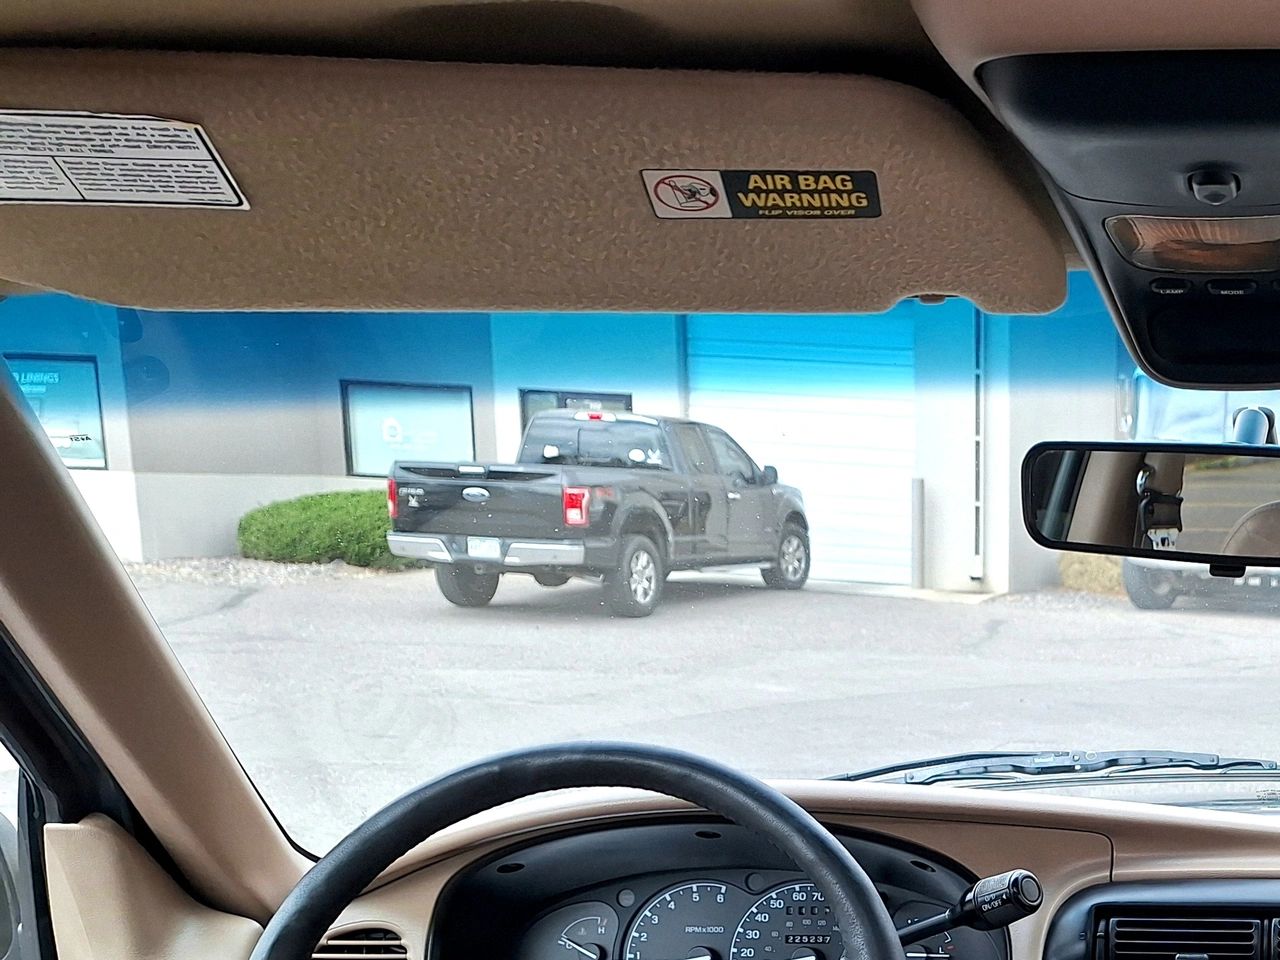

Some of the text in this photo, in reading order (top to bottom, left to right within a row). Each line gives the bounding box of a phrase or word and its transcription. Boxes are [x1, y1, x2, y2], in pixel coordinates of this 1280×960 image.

[748, 174, 853, 190] AIR BAG
[737, 191, 868, 207] WARNING
[692, 894, 699, 902] 5
[717, 895, 724, 903] 6
[792, 892, 806, 901] 60
[667, 902, 676, 910] 4
[769, 900, 784, 908] 50
[651, 915, 659, 924] 3
[755, 913, 769, 922] 40
[640, 932, 648, 941] 2
[745, 930, 759, 939] 30
[788, 936, 830, 944] 225237
[635, 952, 641, 960] 1
[740, 948, 754, 957] 20
